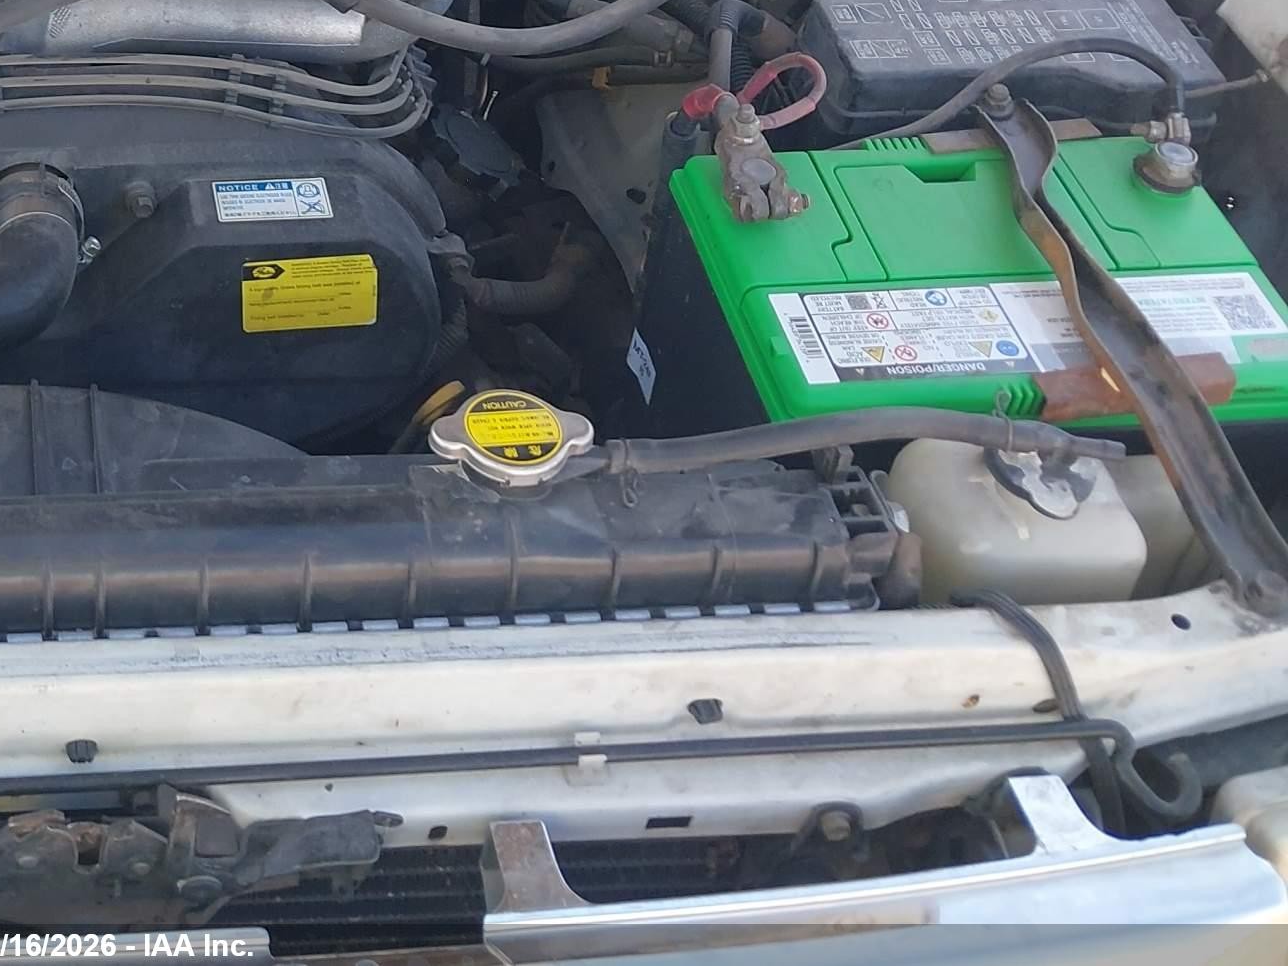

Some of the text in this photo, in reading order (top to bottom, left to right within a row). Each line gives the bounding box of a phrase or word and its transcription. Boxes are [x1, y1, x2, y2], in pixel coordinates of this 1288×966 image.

[218, 183, 258, 191] NOTICE
[884, 360, 986, 375] DANGER/POISON
[482, 400, 527, 411] CAUTION
